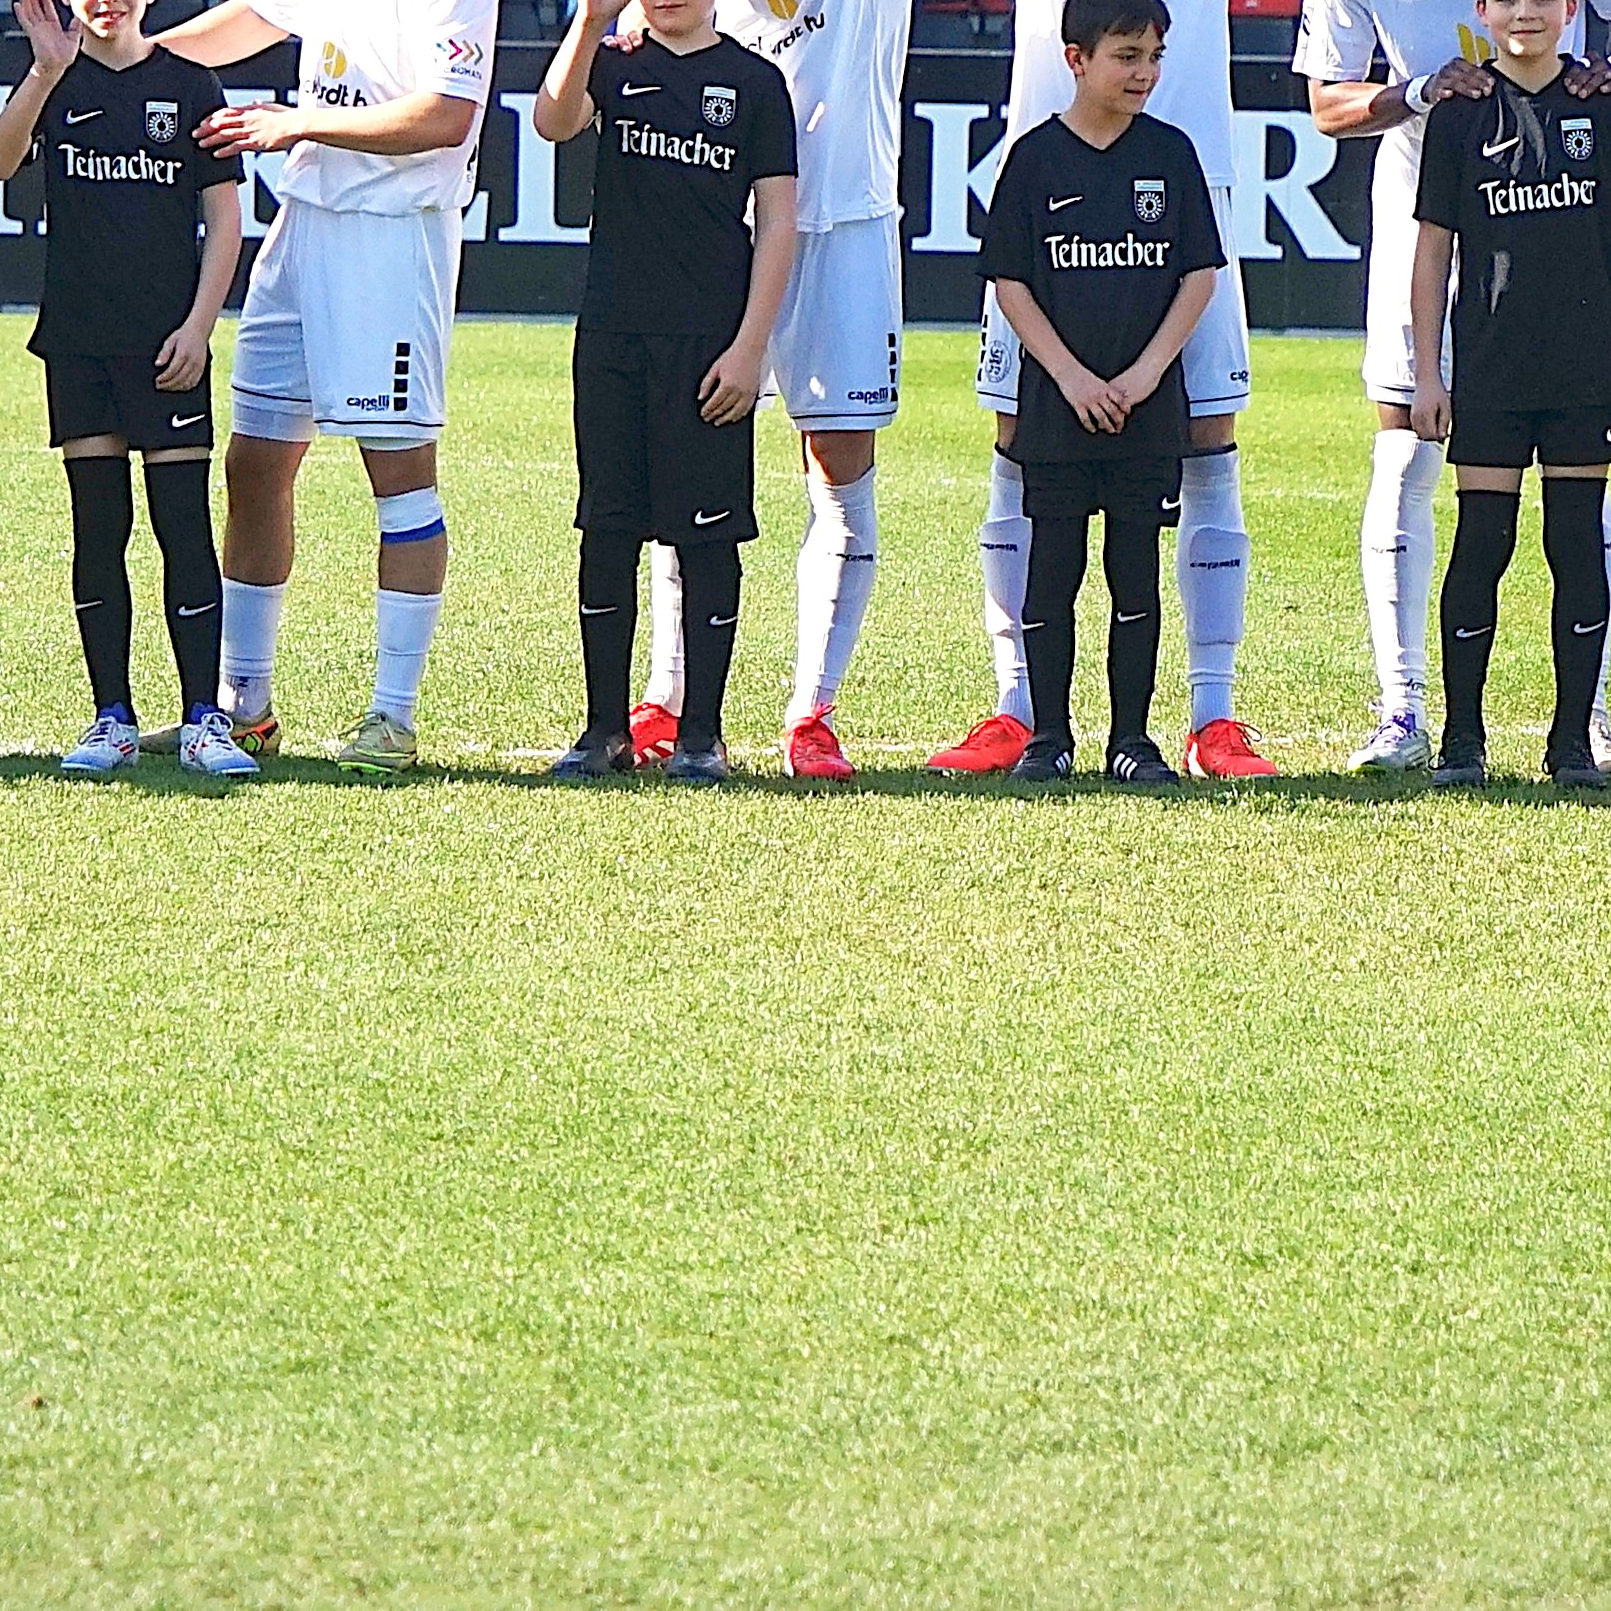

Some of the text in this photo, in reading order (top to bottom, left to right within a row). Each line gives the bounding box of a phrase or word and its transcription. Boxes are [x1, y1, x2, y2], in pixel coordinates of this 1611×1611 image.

[57, 143, 183, 185] Teinacher
[614, 119, 736, 171] Teinacher
[1478, 172, 1596, 215] Teinacher
[1044, 232, 1171, 269] Teinacher
[346, 394, 390, 411] capelli
[847, 387, 889, 404] capelli
